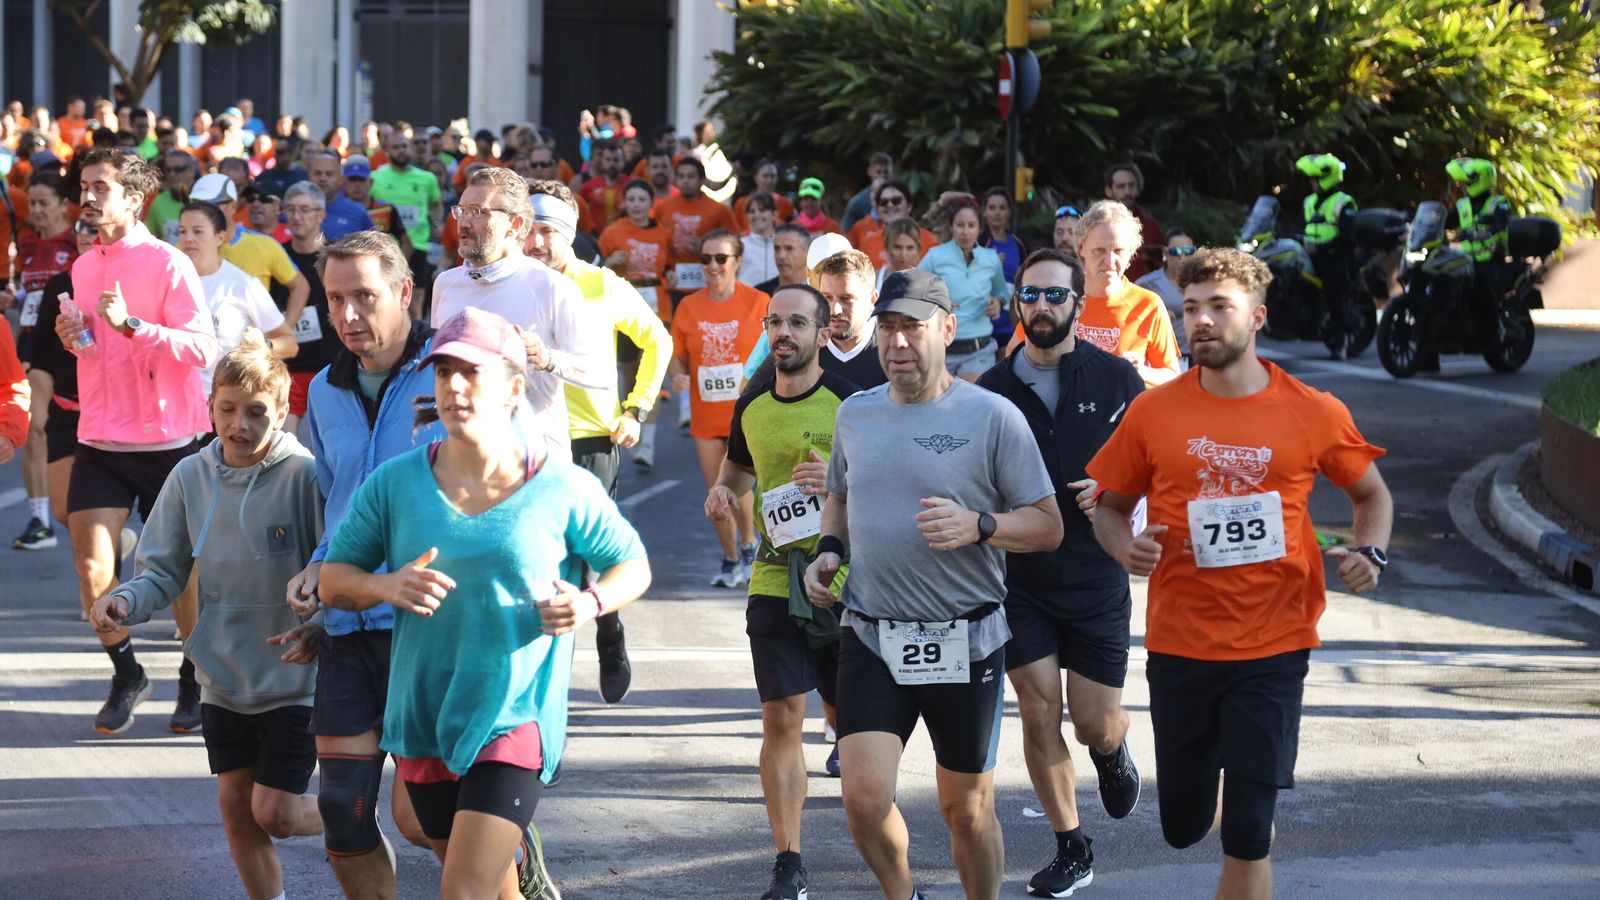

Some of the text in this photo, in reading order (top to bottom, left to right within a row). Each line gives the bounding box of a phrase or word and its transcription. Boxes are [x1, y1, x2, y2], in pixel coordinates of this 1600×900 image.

[704, 377, 735, 390] 685
[768, 495, 821, 526] 1061
[1203, 518, 1266, 545] 793
[903, 643, 941, 665] 29
